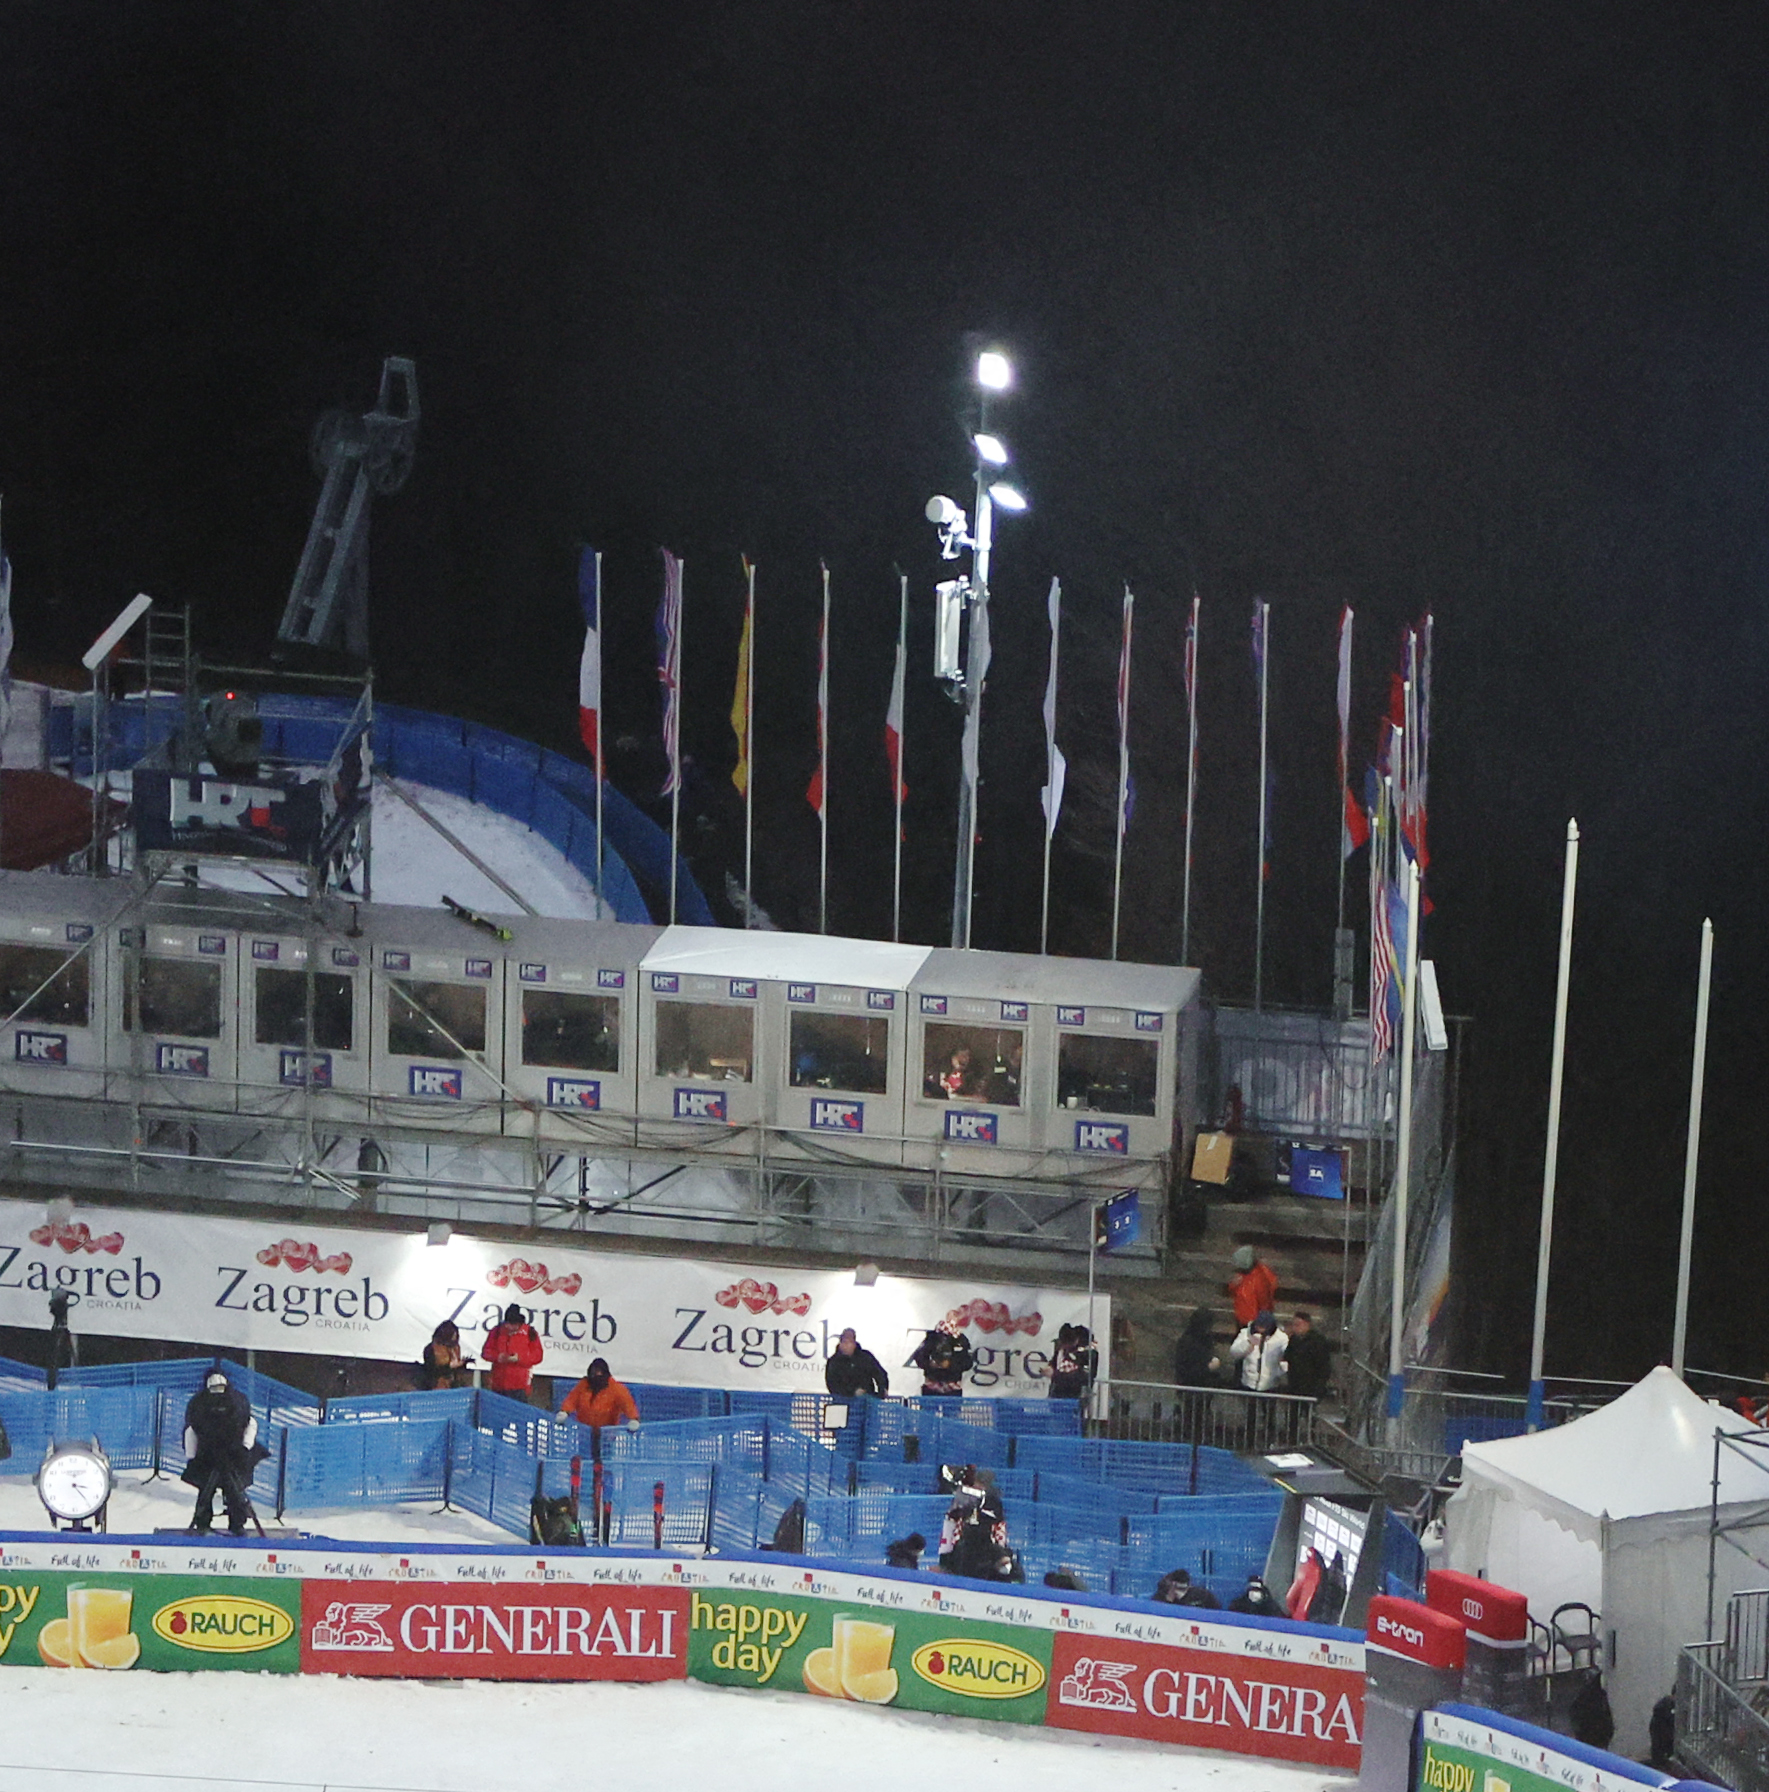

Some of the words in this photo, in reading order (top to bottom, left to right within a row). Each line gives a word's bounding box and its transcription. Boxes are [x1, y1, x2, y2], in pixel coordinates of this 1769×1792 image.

[170, 778, 286, 837] HRT
[21, 1035, 62, 1061] HRT
[415, 1070, 457, 1094] HRT
[552, 1082, 596, 1105] HRT
[679, 1093, 722, 1116] HRT
[816, 1103, 859, 1127] HRT
[950, 1114, 994, 1139] HRT
[1080, 1125, 1124, 1149] HRT
[86, 1299, 143, 1312] CROATIA
[215, 1266, 390, 1327] Zagreb
[315, 1318, 370, 1332] CROATIA
[543, 1340, 599, 1354] CROATIA
[1004, 1379, 1050, 1391] CROAT
[191, 1611, 275, 1638] RAUCH
[690, 1592, 808, 1645] happy
[399, 1604, 678, 1660] GENERALI
[1377, 1617, 1424, 1647] e-tron
[710, 1633, 785, 1685] day
[948, 1655, 1028, 1687] RAUCH
